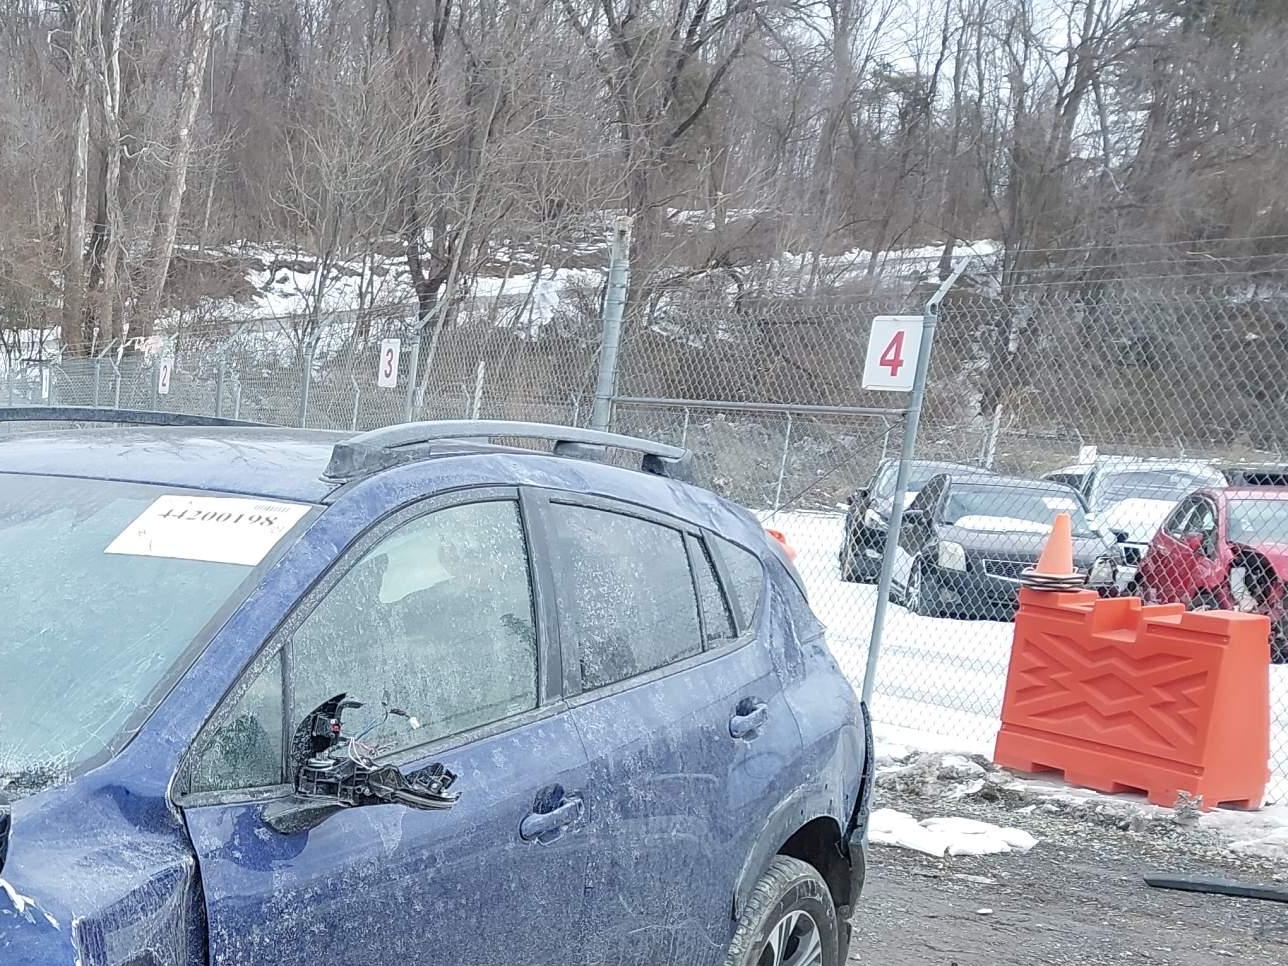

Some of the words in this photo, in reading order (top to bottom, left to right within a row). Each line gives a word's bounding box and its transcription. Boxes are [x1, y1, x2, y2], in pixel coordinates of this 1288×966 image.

[384, 348, 394, 379] 3
[879, 330, 905, 377] 4
[161, 364, 168, 387] 2
[158, 508, 278, 526] 44200198
